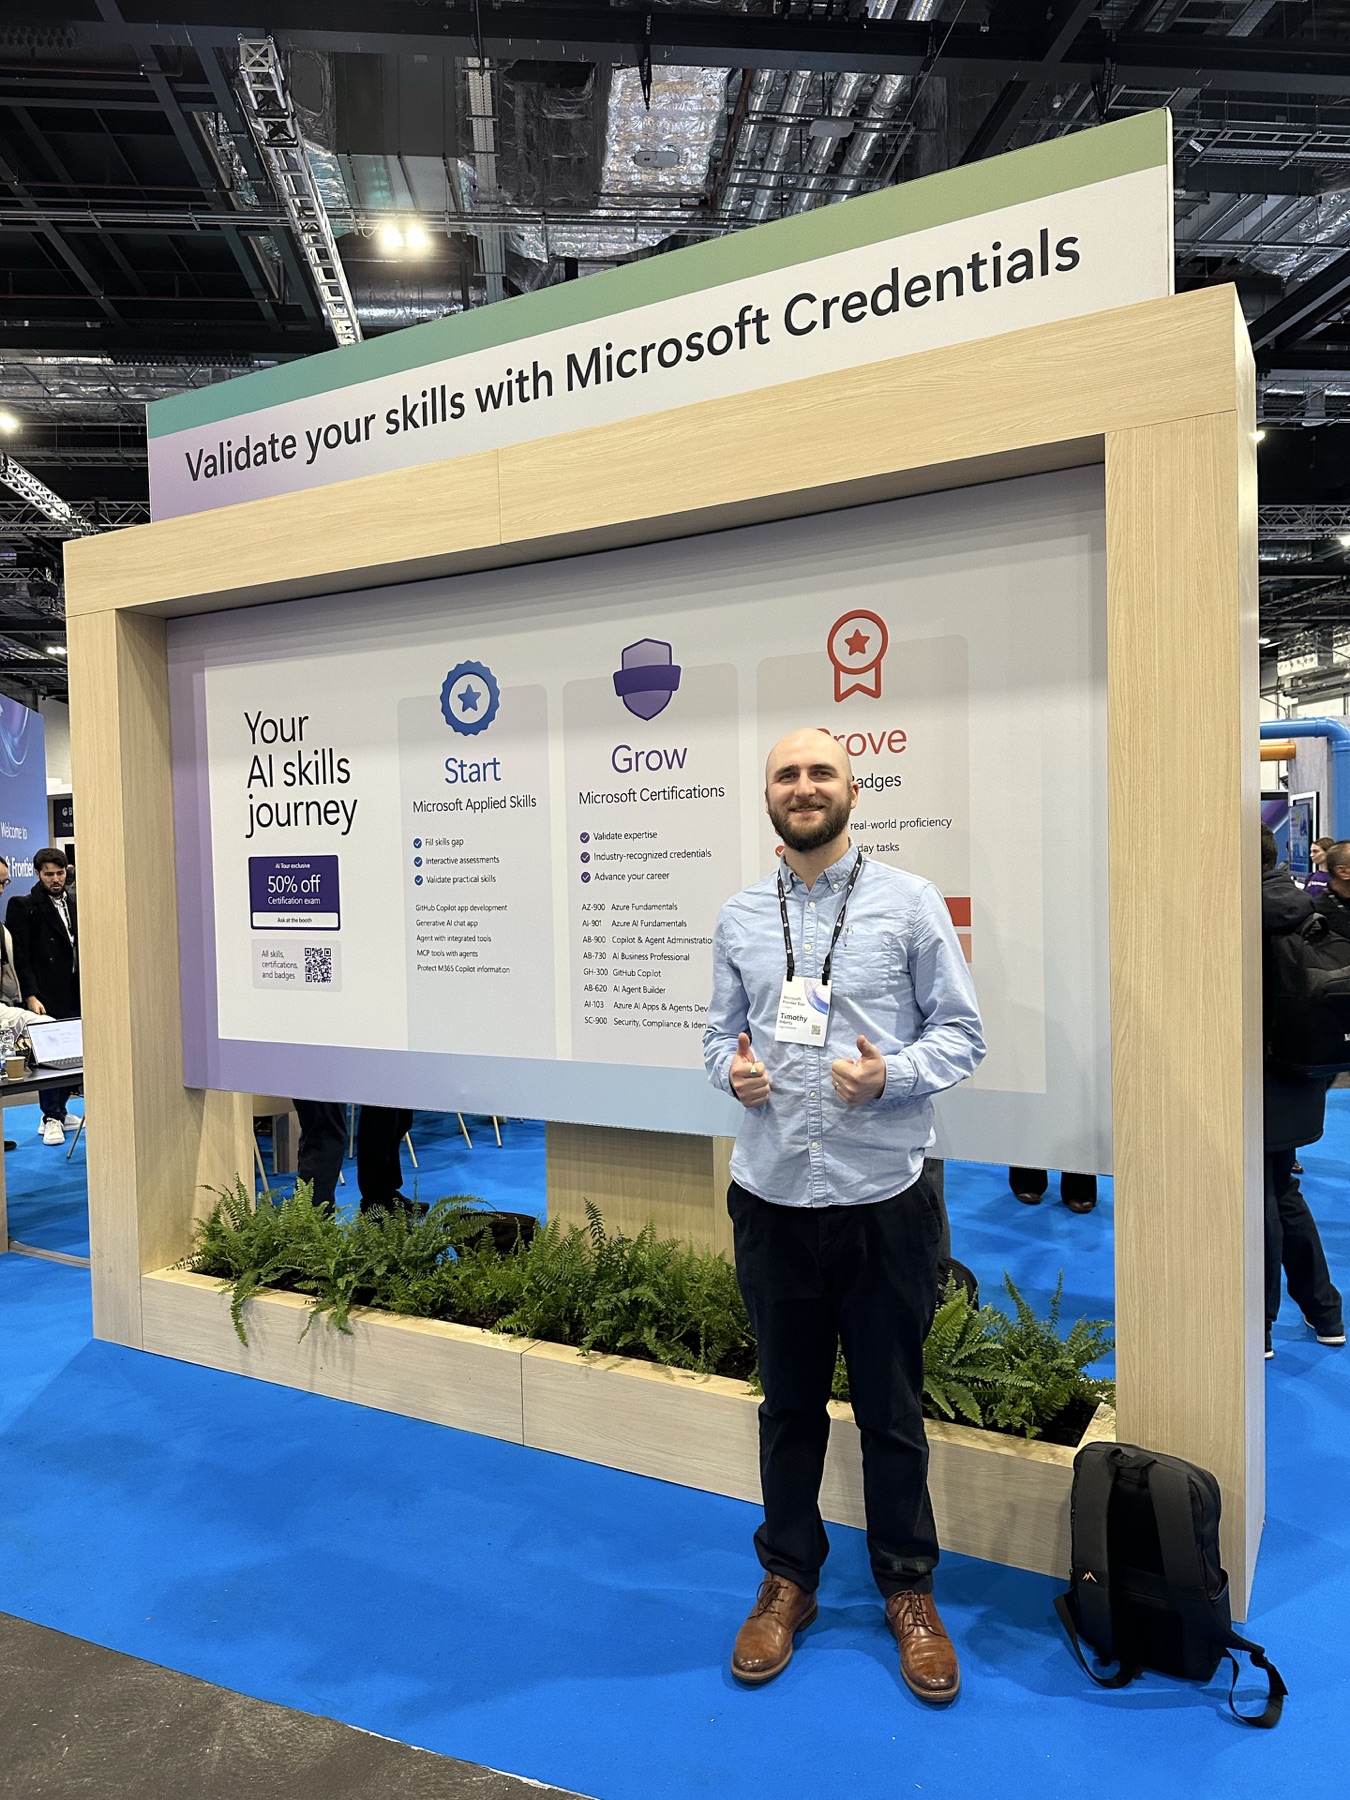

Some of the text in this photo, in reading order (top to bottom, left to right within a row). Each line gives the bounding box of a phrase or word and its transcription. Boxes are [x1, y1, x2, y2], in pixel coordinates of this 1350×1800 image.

[185, 227, 1081, 482] Validate your skills with Microsoft Credentials
[244, 710, 309, 745] Your
[817, 727, 907, 757] rove
[611, 744, 688, 774] Grow
[247, 748, 351, 788] AI skills
[444, 757, 502, 784] Start
[850, 773, 902, 792] adges
[579, 785, 725, 805] Microsoft Certifications
[413, 794, 537, 814] Microsoft Applied Skills
[245, 793, 358, 838] journey
[850, 817, 952, 830] real-world proficiency
[0, 821, 22, 839] Welcome
[593, 830, 658, 841] Validate expertise
[435, 838, 450, 846] skills
[451, 838, 464, 848] gap
[856, 842, 900, 854] day tasks
[426, 856, 500, 864] Interactive assessments
[594, 848, 712, 862] Industry-recognized credentials
[452, 875, 480, 885] practical
[481, 874, 496, 883] skills
[594, 872, 670, 882] Advance your career
[267, 874, 321, 893] 50% off
[268, 896, 321, 905] Certification exam
[436, 904, 457, 913] Copilot
[470, 904, 508, 912] development
[632, 903, 678, 911] Fundamentals
[416, 935, 433, 943] Agent
[447, 935, 476, 944] integrated
[611, 936, 636, 945] Copilot
[644, 936, 665, 945] Agent
[666, 936, 713, 944] Administratio
[270, 950, 284, 959] skills,
[459, 950, 478, 959] agents
[621, 952, 648, 960] Business
[650, 952, 690, 961] Professional
[262, 961, 299, 970] certifications,
[455, 965, 476, 974] Copilot
[477, 965, 510, 974] information
[274, 972, 296, 981] badges
[583, 968, 662, 978] GH-300 GitHub Copilot
[621, 985, 641, 995] Agent
[643, 986, 666, 994] Builder
[584, 1000, 604, 1008] AI-103
[613, 1001, 632, 1009] Azure
[642, 1002, 660, 1012] Apps
[661, 1003, 667, 1011] &
[669, 1003, 692, 1013] Agents
[694, 1004, 708, 1012] Dev
[584, 1016, 707, 1029] SC-900 Security, Compliance & Iden
[781, 1012, 808, 1023] Timothy
